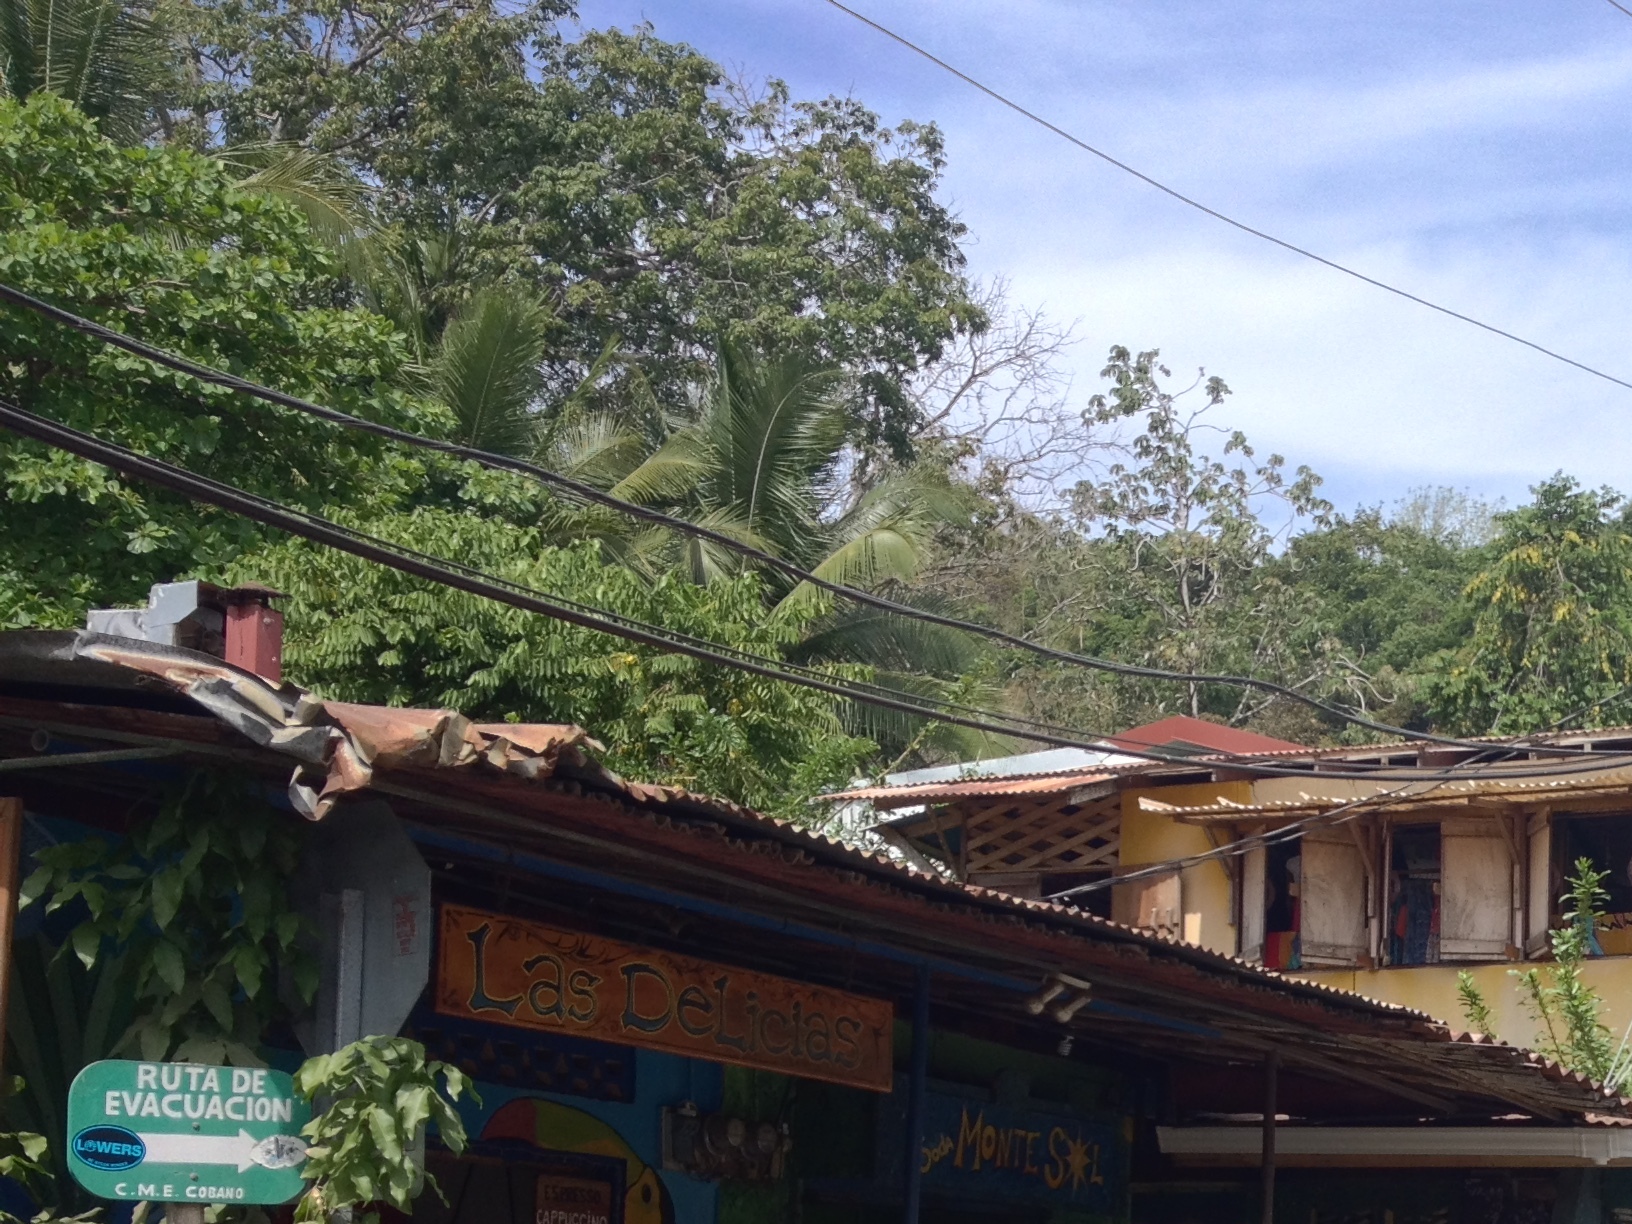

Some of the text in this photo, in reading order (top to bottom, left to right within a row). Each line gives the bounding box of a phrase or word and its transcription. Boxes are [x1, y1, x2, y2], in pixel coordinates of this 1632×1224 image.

[466, 921, 603, 1024] Las
[137, 1064, 267, 1095] RUTA DE
[105, 1090, 292, 1123] EVACUACION
[954, 1105, 1041, 1176] MONTE
[185, 1185, 244, 1200] COBANO
